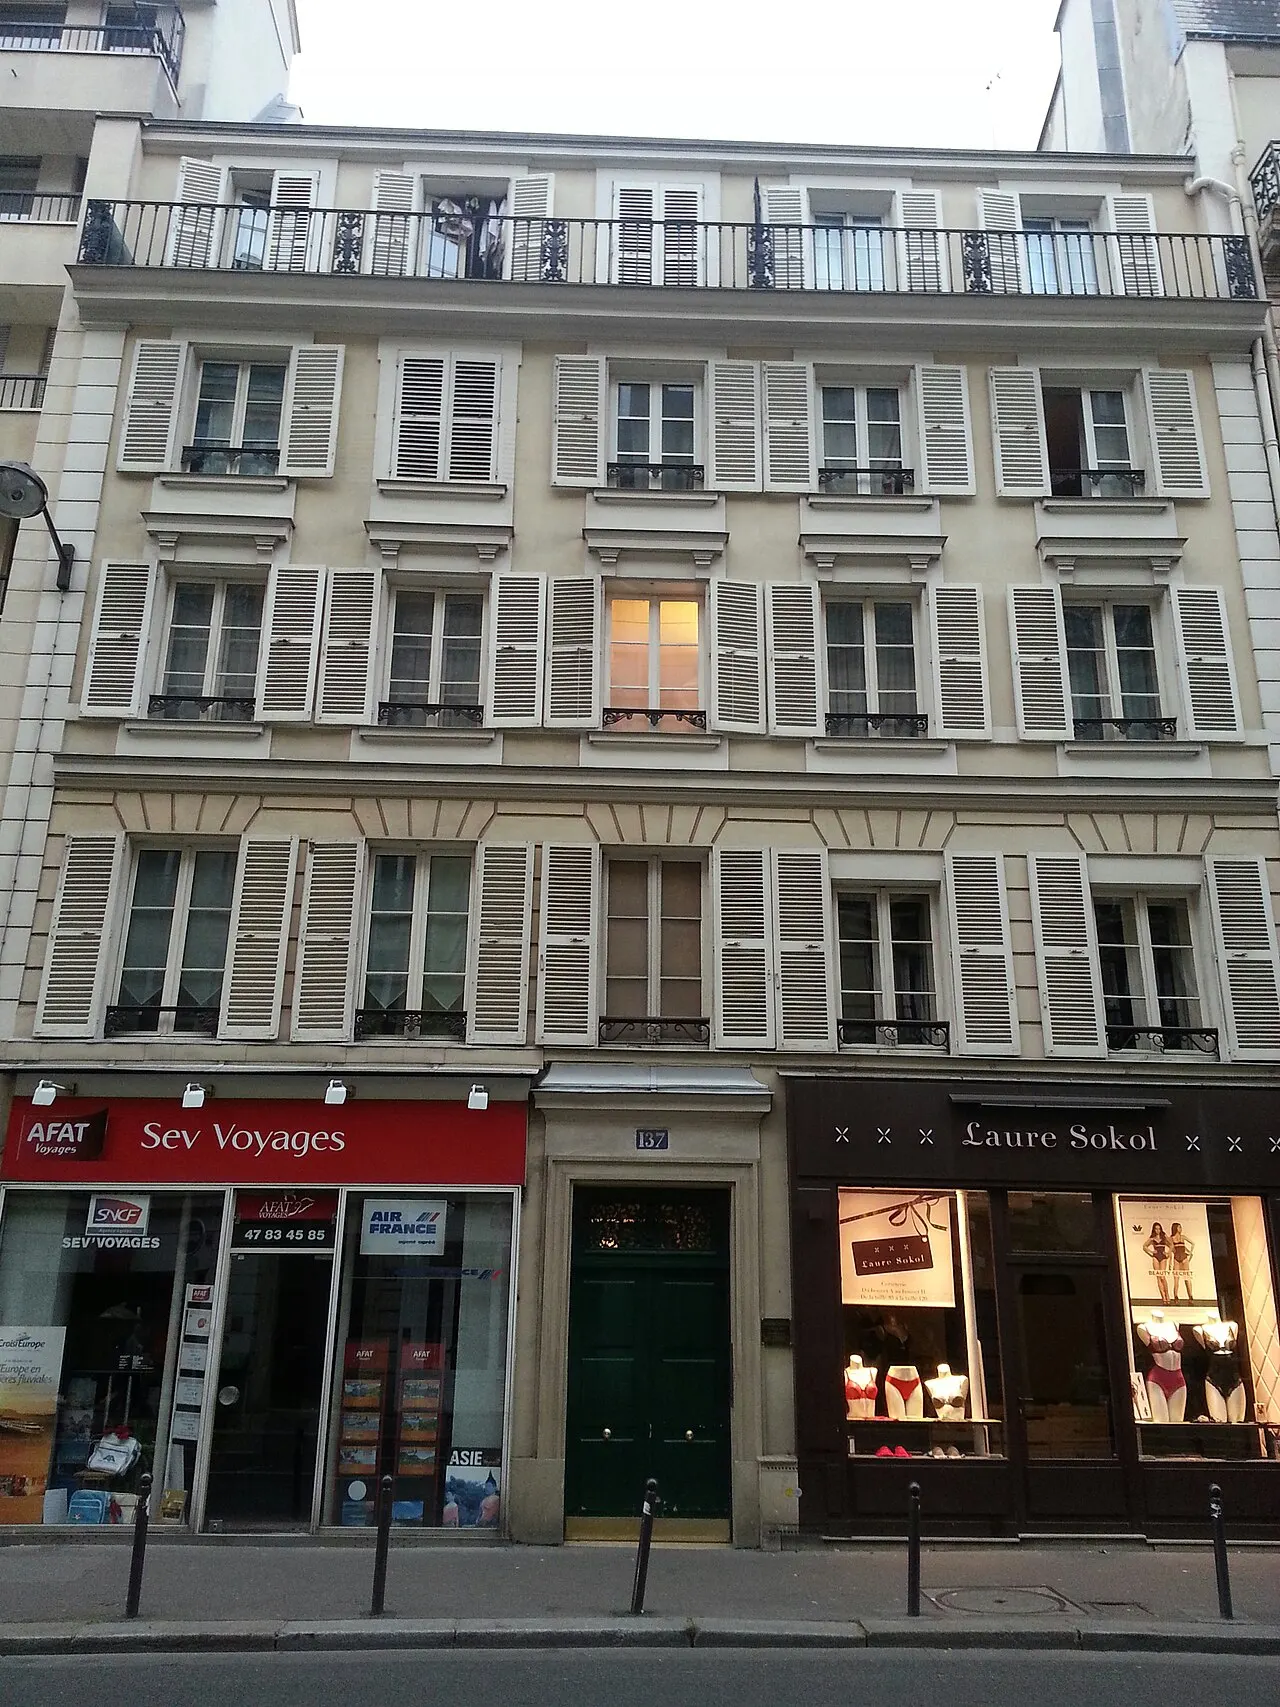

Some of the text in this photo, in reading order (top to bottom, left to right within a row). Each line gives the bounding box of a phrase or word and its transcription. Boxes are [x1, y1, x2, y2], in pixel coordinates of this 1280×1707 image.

[27, 1122, 90, 1142] AFAT
[962, 1122, 1158, 1150] Laure Sokol
[141, 1122, 345, 1157] Sev Voyages
[638, 1131, 665, 1148] 137
[35, 1143, 77, 1155] Voyages
[259, 1201, 293, 1212] AFAT
[95, 1208, 140, 1222] SNCF
[370, 1211, 402, 1222] AIR
[369, 1223, 437, 1234] FRANCE
[244, 1229, 325, 1241] 47 83 45 85
[62, 1237, 161, 1249] SEV'VOYAGES
[861, 1254, 926, 1269] Laure Sokol
[413, 1350, 430, 1358] AFAT
[31, 1366, 41, 1374] en
[449, 1450, 483, 1466] ASIE
